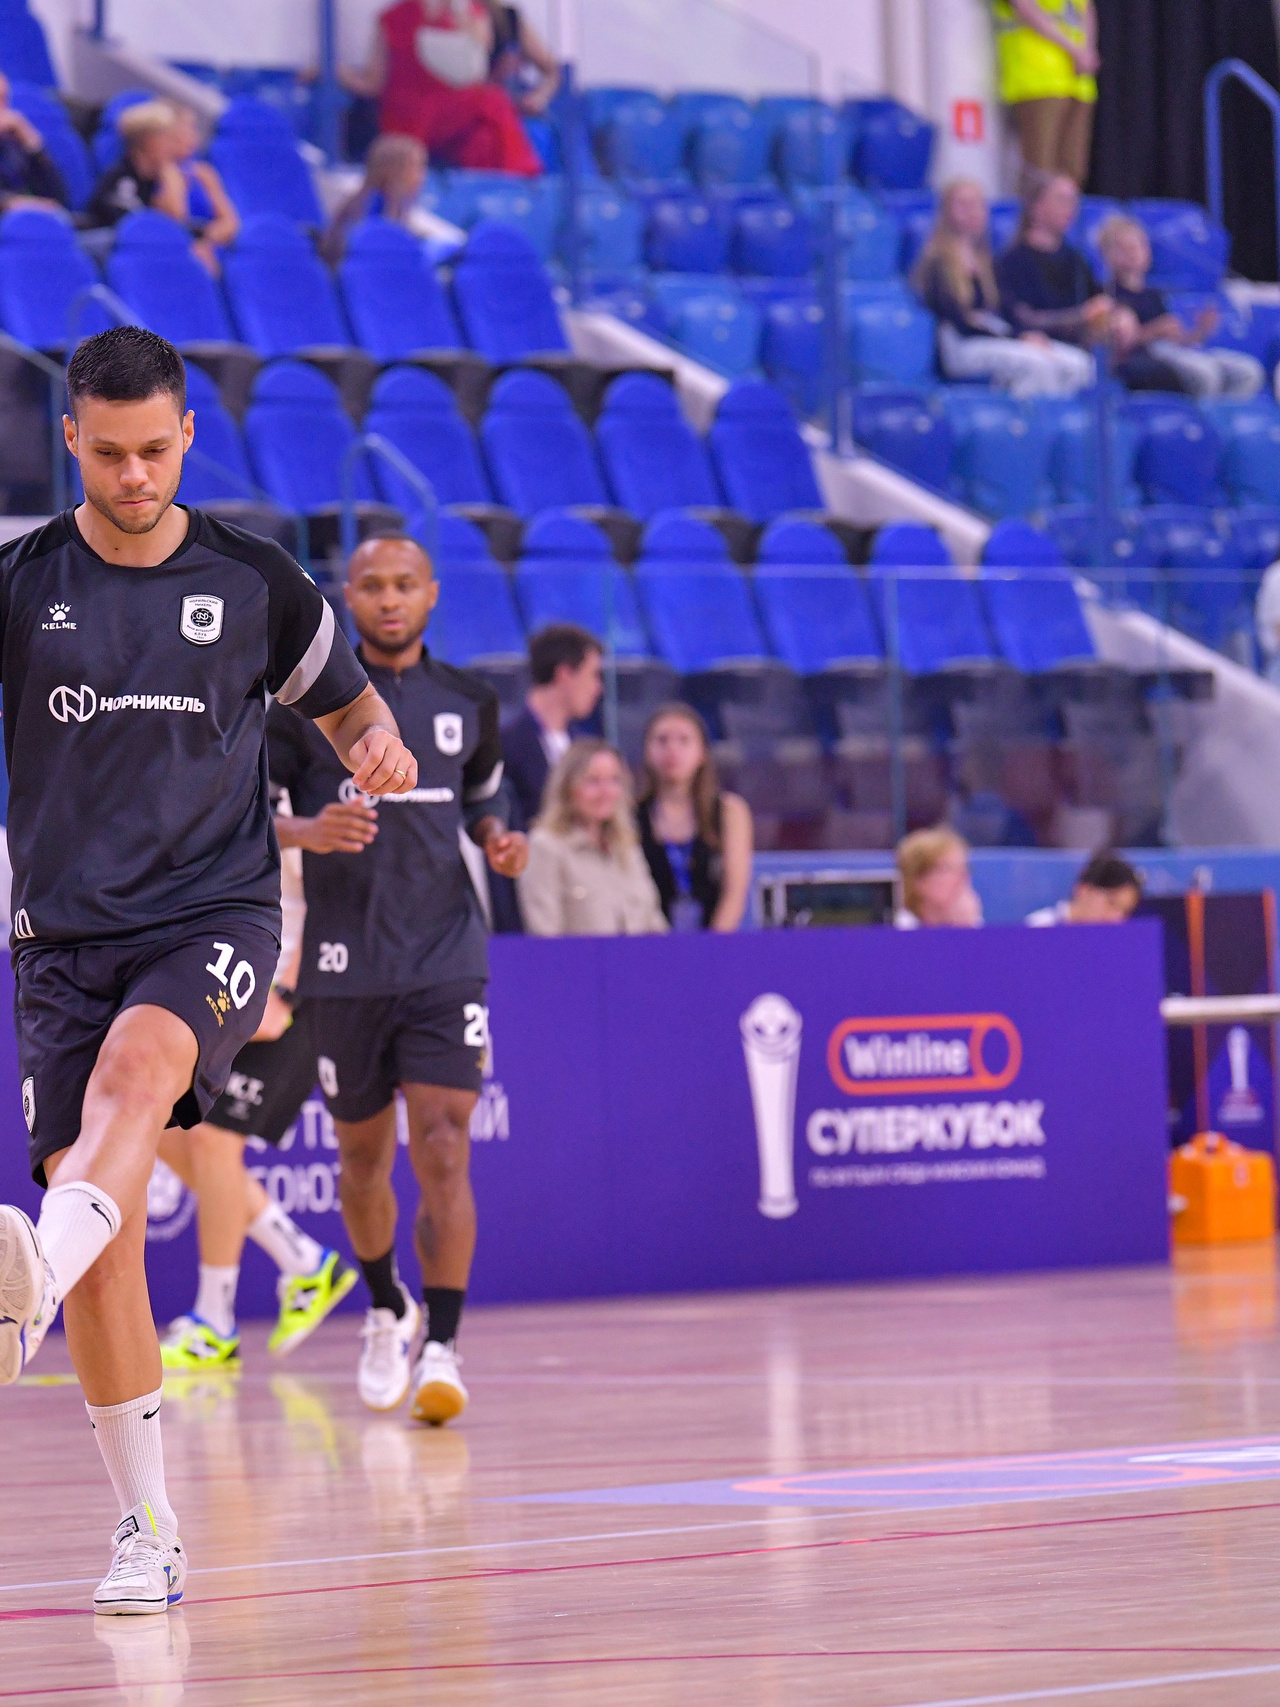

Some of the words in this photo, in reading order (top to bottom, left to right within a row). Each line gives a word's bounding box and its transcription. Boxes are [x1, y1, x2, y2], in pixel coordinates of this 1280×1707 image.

[42, 622, 77, 630] KELME
[99, 695, 205, 712] НОРНИКЕЛЬ
[205, 941, 257, 1010] 10
[318, 941, 349, 974] 20
[844, 1032, 969, 1079] Winline
[806, 1099, 1046, 1155] СУПЕРКУБОК
